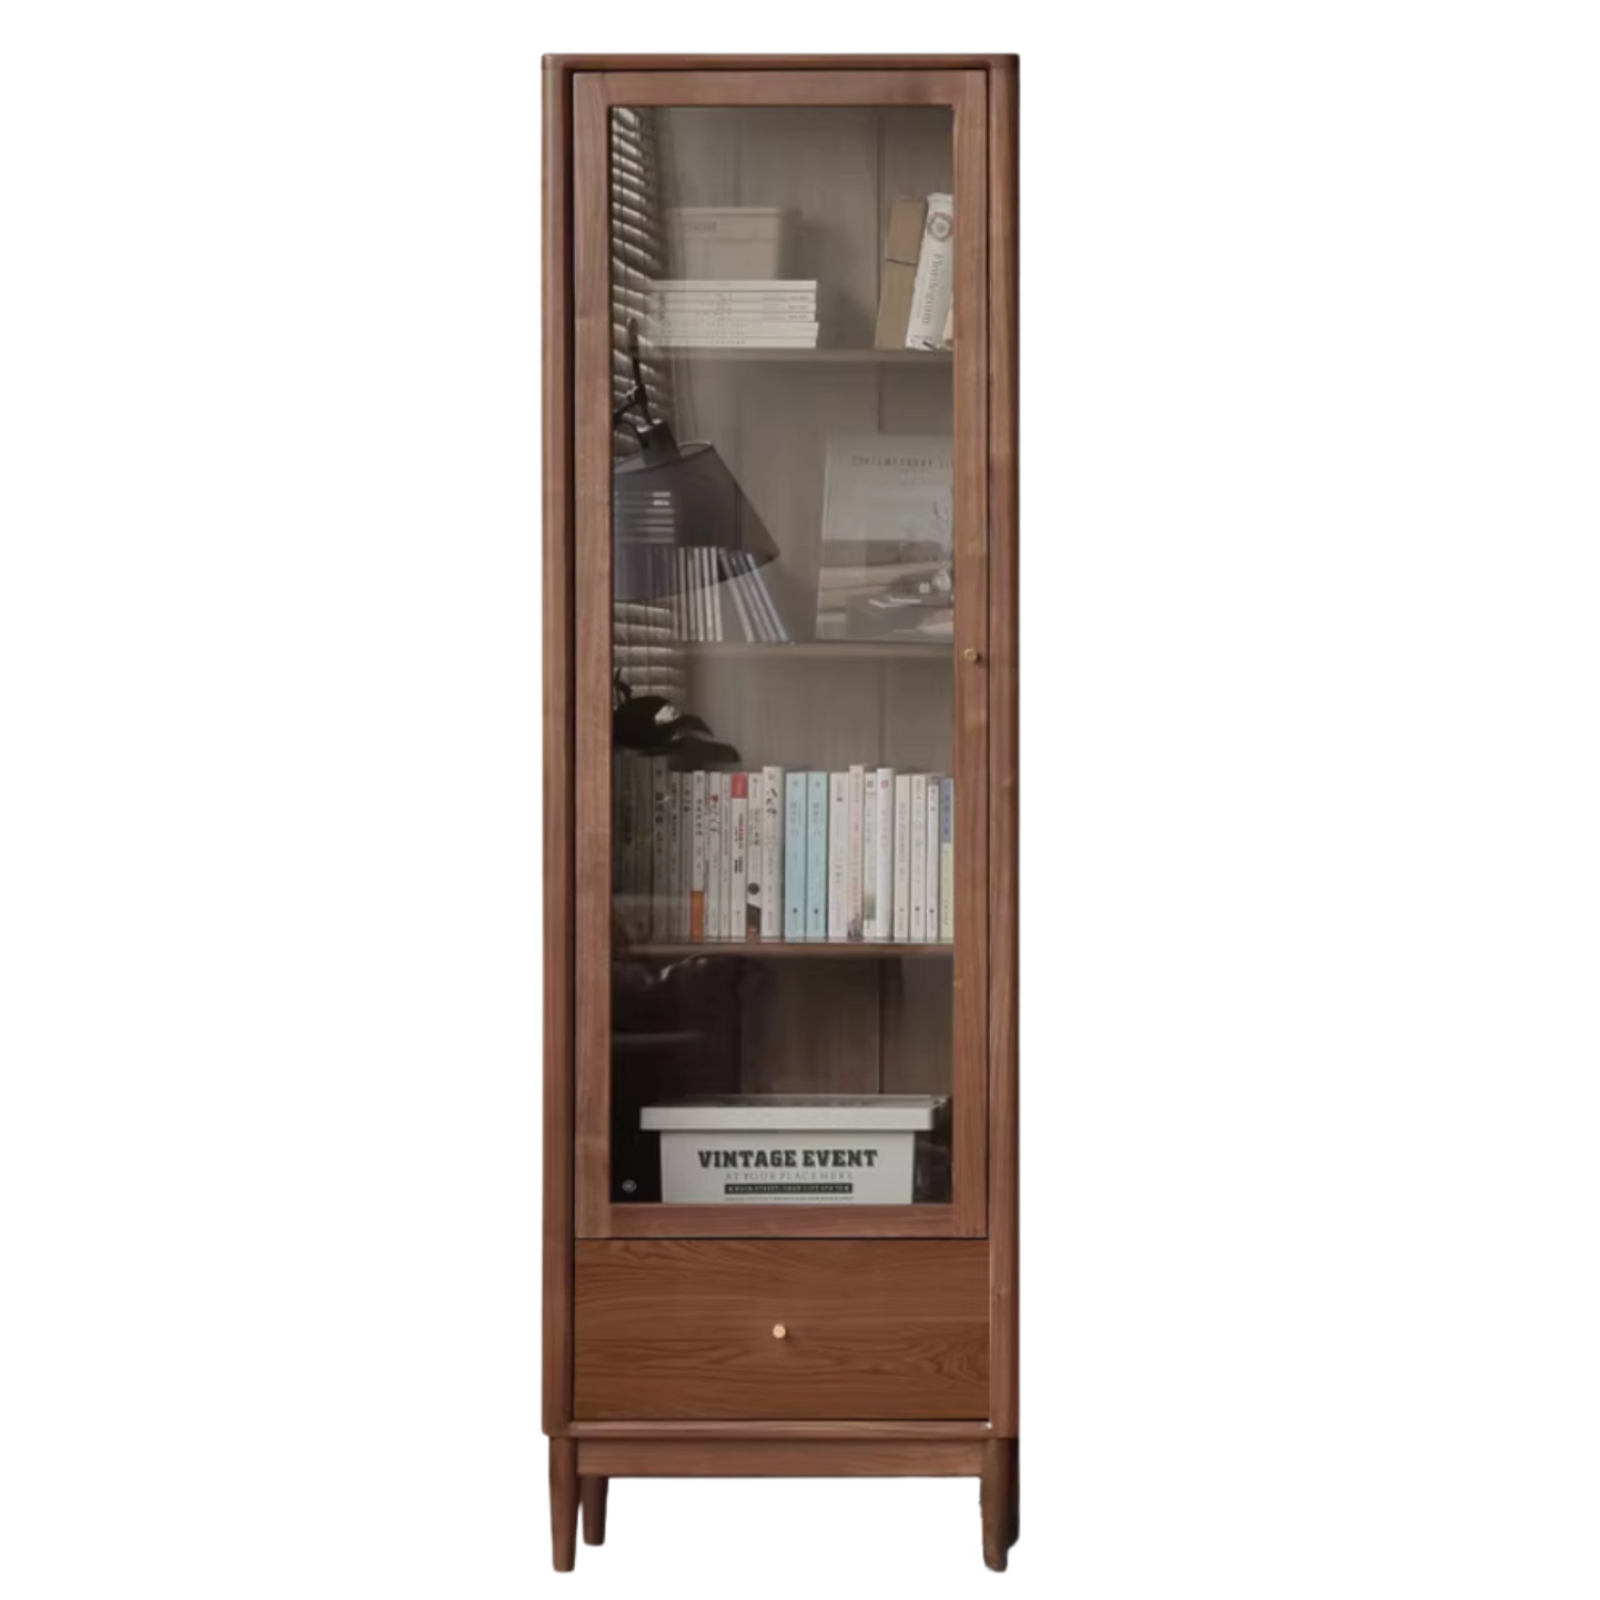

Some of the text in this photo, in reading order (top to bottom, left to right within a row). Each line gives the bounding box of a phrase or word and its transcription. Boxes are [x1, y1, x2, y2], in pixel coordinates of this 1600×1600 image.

[698, 1149, 878, 1168] VINTAGE EVENT
[725, 1171, 738, 1181] AT
[744, 1171, 775, 1181] YOUR
[779, 1171, 815, 1181] PLACE
